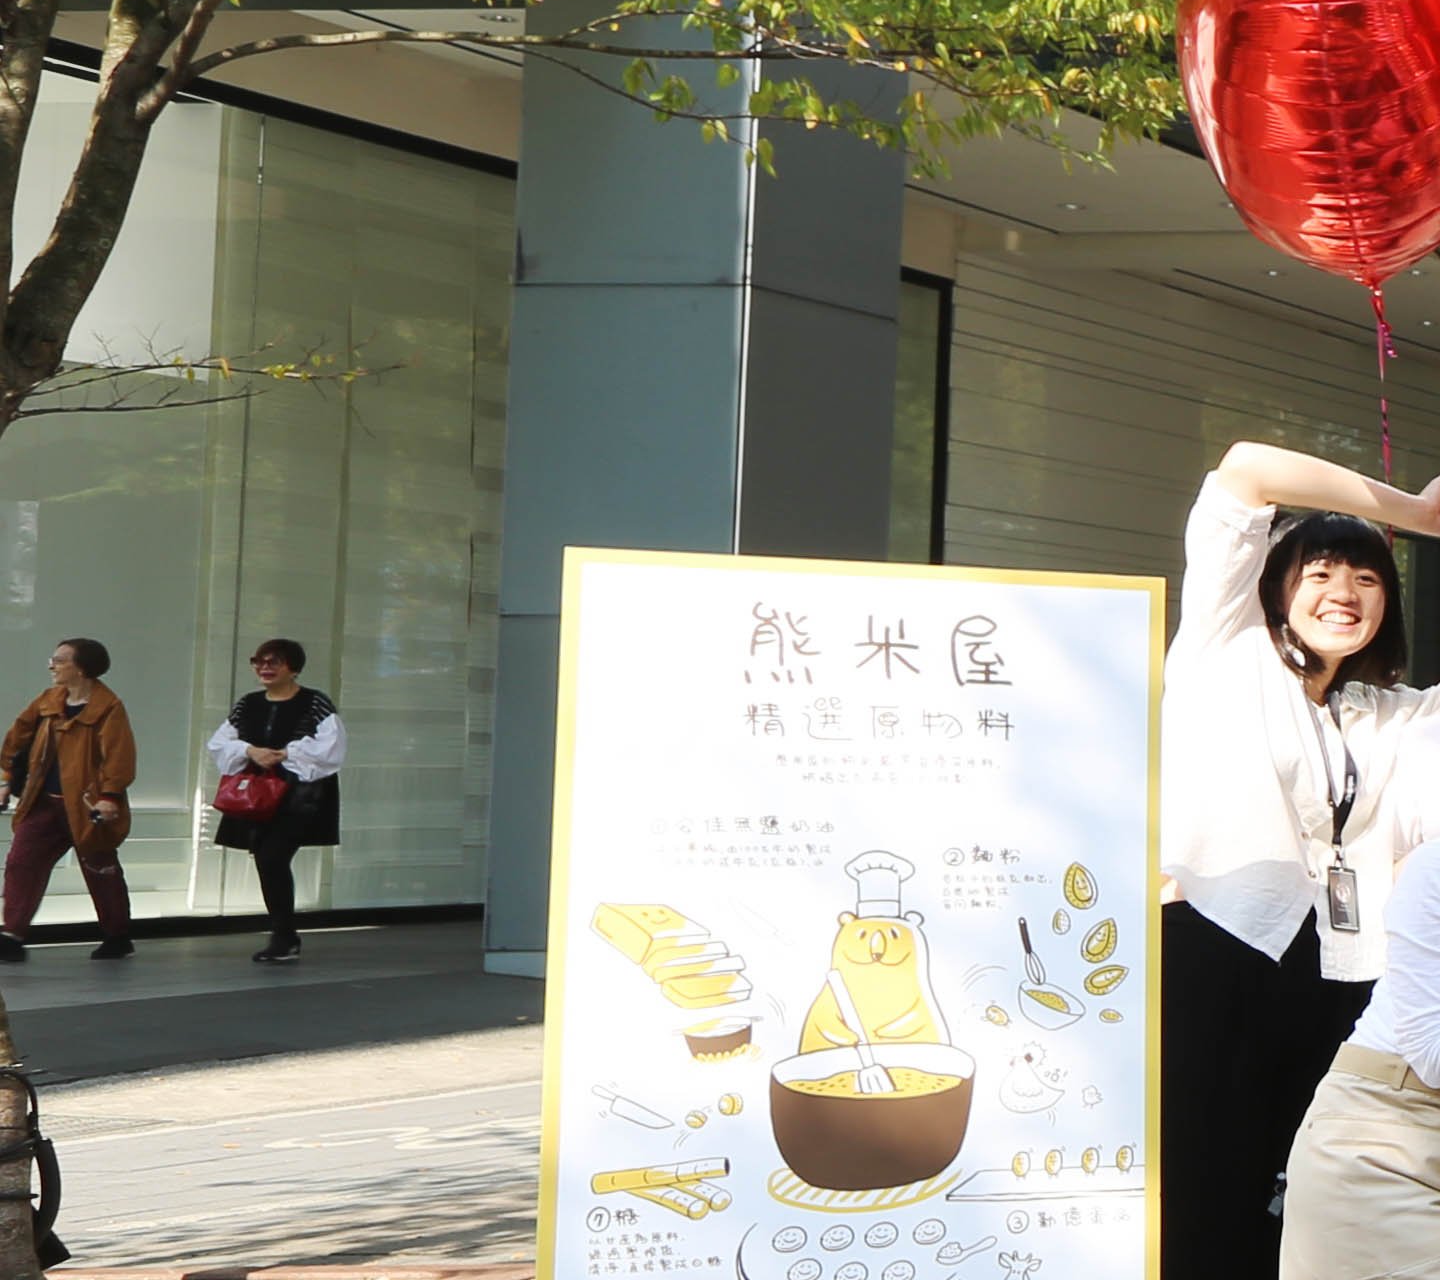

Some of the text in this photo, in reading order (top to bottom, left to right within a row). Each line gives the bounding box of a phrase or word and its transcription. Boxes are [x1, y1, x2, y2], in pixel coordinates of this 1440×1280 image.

[743, 601, 1013, 687] 熊米屋
[744, 696, 1015, 742] 精選原物料
